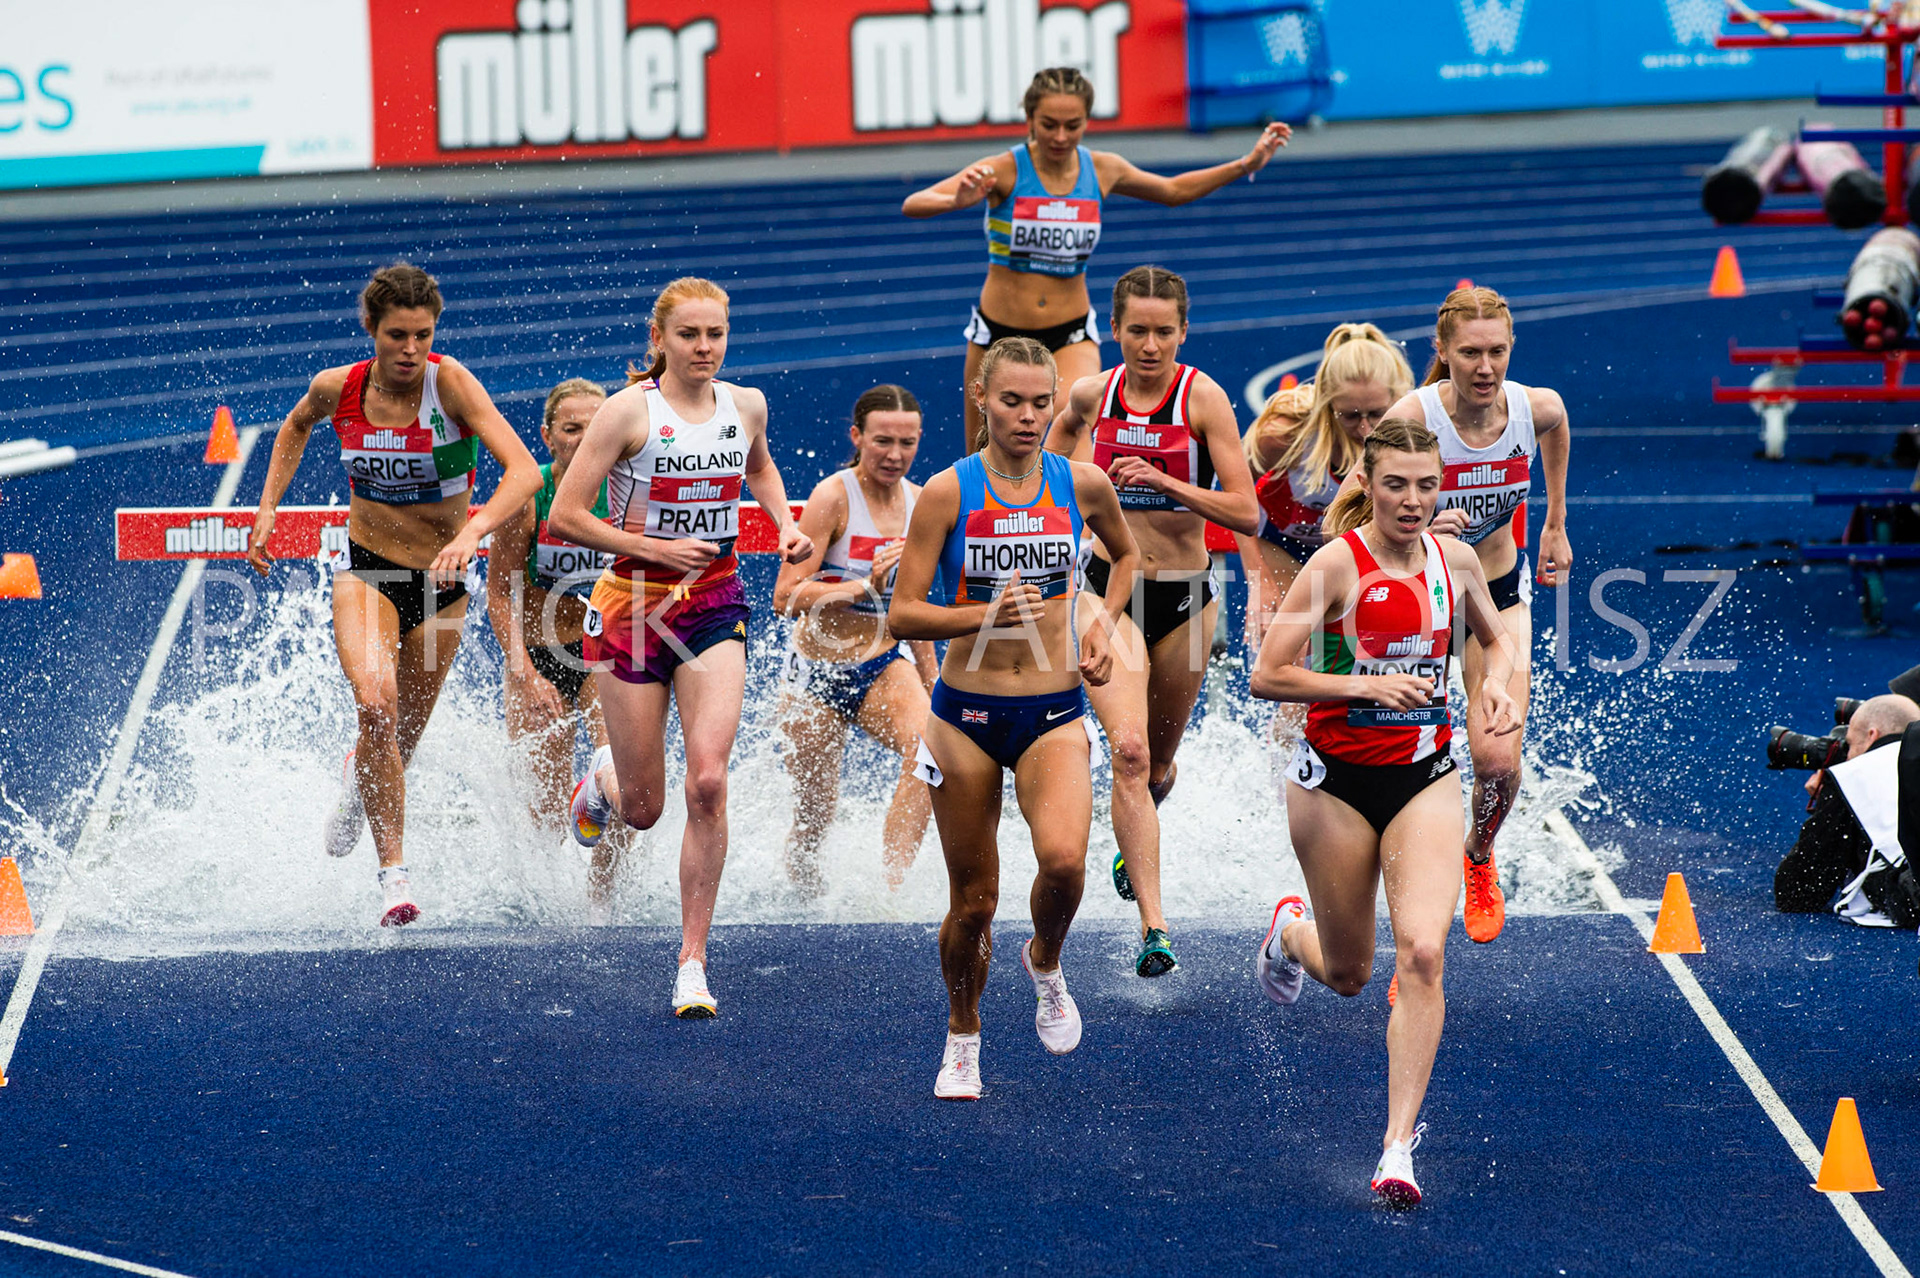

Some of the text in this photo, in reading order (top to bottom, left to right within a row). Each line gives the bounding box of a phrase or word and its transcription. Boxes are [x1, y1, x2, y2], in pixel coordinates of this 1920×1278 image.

[436, 0, 718, 149] müller
[851, 0, 1131, 132] müller
[1037, 201, 1079, 220] müller
[1014, 226, 1096, 250] BARBOUR
[363, 429, 408, 450] müller
[1116, 426, 1162, 448] müller
[352, 456, 426, 480] GRICE
[655, 451, 743, 474] ENGLAND
[1457, 464, 1507, 487] müller
[677, 480, 724, 501] müller
[1432, 488, 1527, 521] AWRENCE
[657, 506, 731, 533] PRATT
[993, 511, 1045, 534] müller
[165, 516, 252, 554] müller
[968, 541, 1071, 571] THORNER
[1386, 635, 1435, 656] müller
[1376, 711, 1431, 720] MANCHESTER
